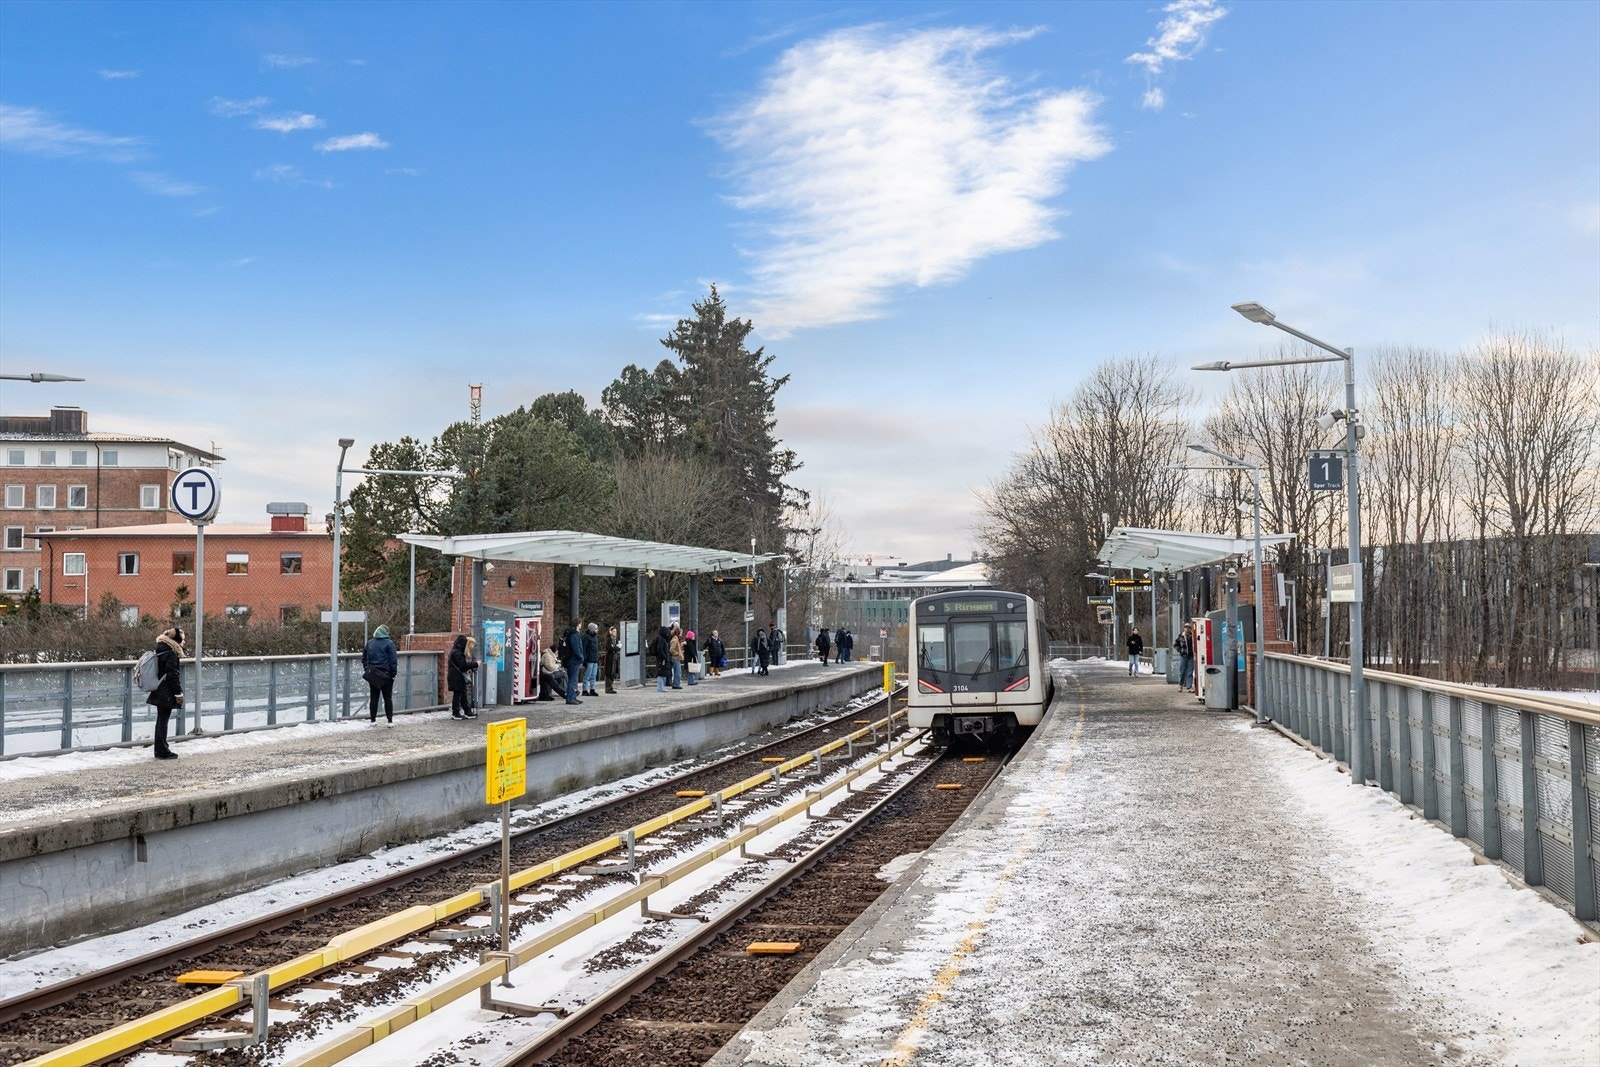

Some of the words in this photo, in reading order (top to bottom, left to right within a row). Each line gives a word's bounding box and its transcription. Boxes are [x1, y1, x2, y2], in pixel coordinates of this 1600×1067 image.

[1321, 462, 1328, 480] 1
[183, 482, 206, 510] T
[944, 602, 950, 612] 5
[955, 603, 993, 611] Ringen
